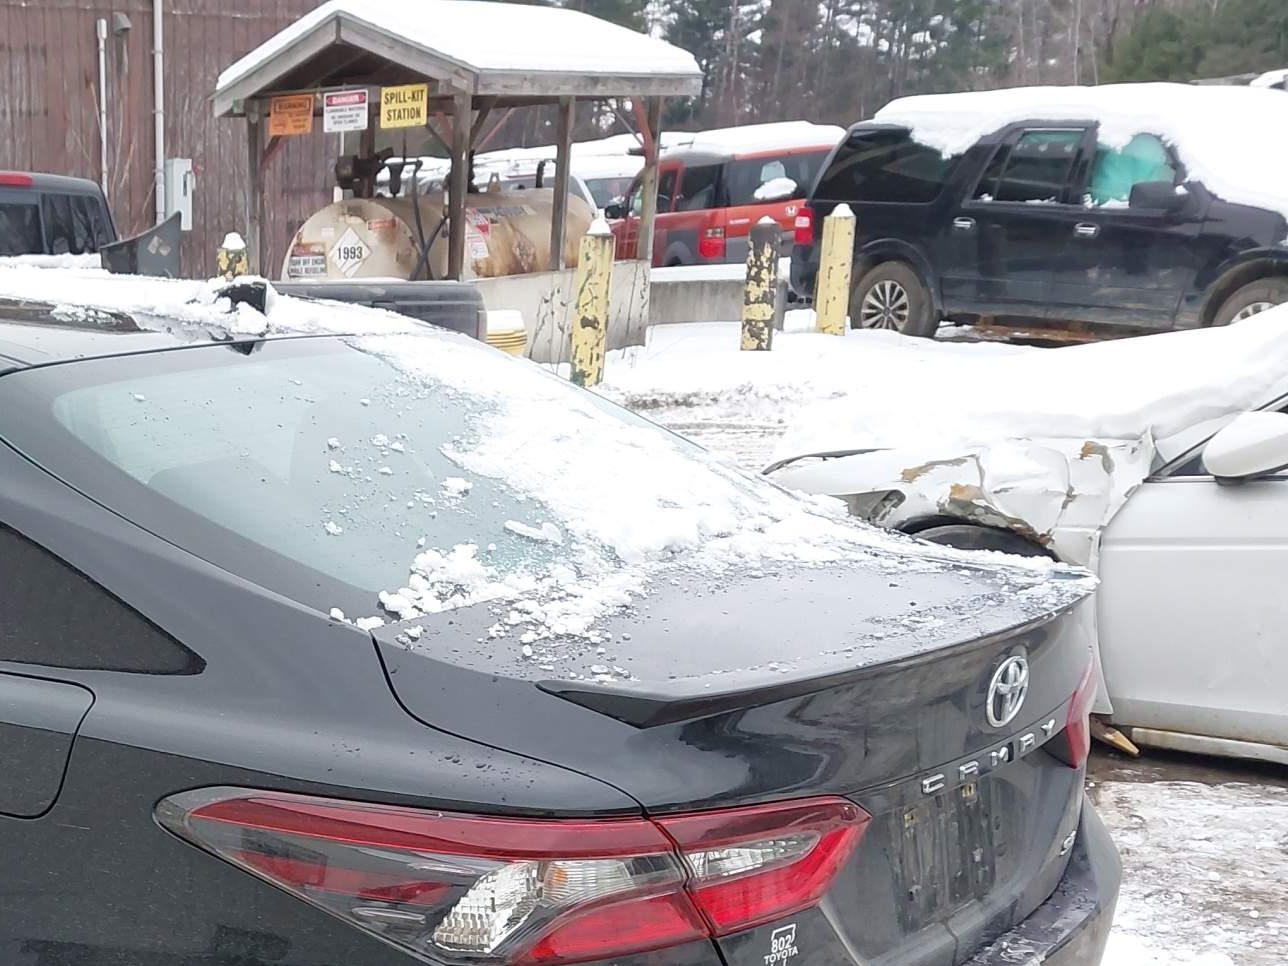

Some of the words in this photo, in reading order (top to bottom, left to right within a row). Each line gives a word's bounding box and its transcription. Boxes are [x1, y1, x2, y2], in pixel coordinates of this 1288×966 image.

[384, 89, 425, 105] SPILL-KIT
[386, 106, 422, 122] STATION
[337, 246, 363, 260] 1993
[922, 718, 1056, 795] CAMRY
[771, 934, 792, 953] 802
[763, 945, 799, 965] TOYOTA
